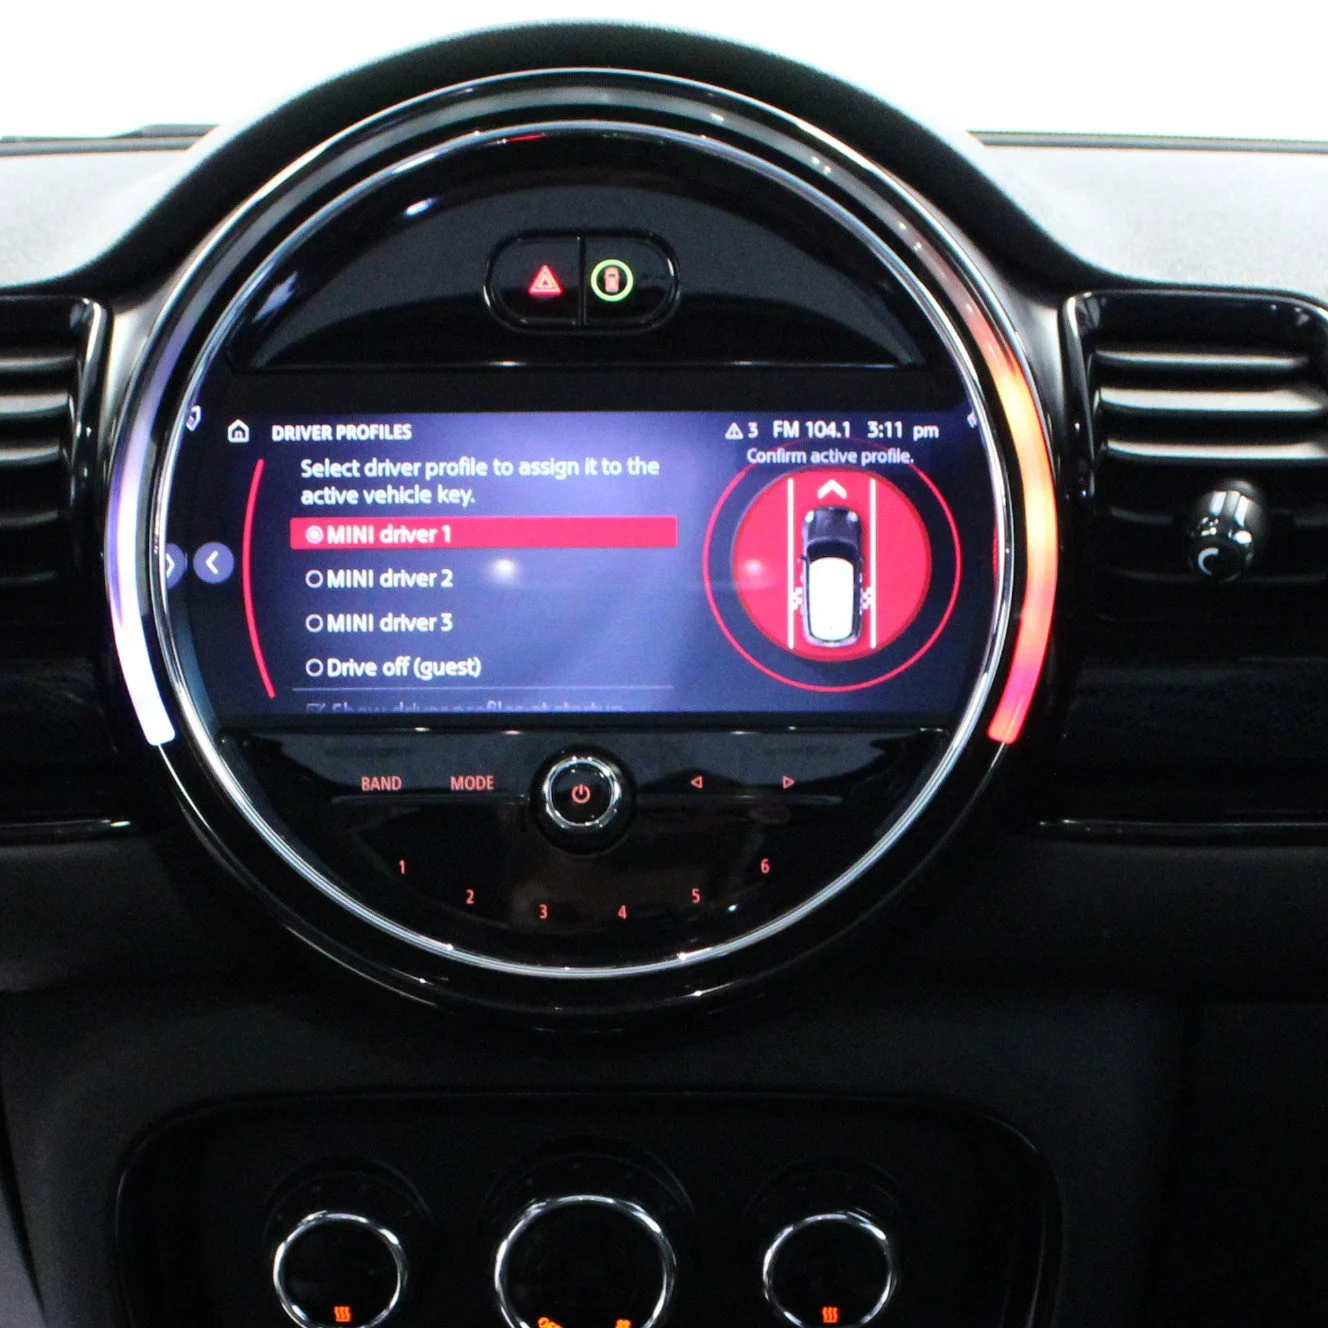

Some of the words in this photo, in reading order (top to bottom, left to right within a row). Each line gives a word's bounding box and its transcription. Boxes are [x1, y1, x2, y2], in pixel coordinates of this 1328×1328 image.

[272, 424, 333, 442] DRIVER
[336, 423, 413, 441] PROFILES
[748, 421, 759, 438] 3
[773, 422, 800, 438] FM
[805, 421, 851, 438] 104.1
[867, 421, 903, 438] 3:11
[913, 425, 939, 442] pm
[746, 447, 807, 464] Confirm
[810, 448, 858, 464] active
[861, 447, 914, 466] profile.
[300, 458, 360, 479] Select
[364, 458, 421, 477] driver
[426, 457, 488, 480] profile
[493, 459, 514, 476] to
[519, 457, 579, 480] assign
[585, 457, 598, 476] it
[602, 459, 622, 476] to
[627, 456, 660, 476] the
[300, 486, 359, 505] active
[364, 485, 431, 504] vehicle
[437, 485, 475, 508] key.
[327, 526, 374, 544] MINI
[380, 525, 437, 544] driver
[441, 525, 451, 542] 1
[327, 570, 374, 588] MINI
[380, 568, 437, 587] driver
[440, 569, 453, 587] 2
[327, 613, 374, 632] MINI
[380, 612, 437, 631] driver
[440, 613, 453, 631] 3
[327, 657, 378, 676] Drive
[382, 656, 410, 676] off
[413, 656, 481, 679] (guest)
[361, 775, 403, 791] BAND
[450, 775, 495, 791] MODE
[398, 859, 406, 874] 1
[760, 858, 770, 874] 6
[466, 890, 474, 904] 2
[691, 888, 701, 904] 5
[539, 904, 548, 919] 3
[617, 904, 627, 919] 4
